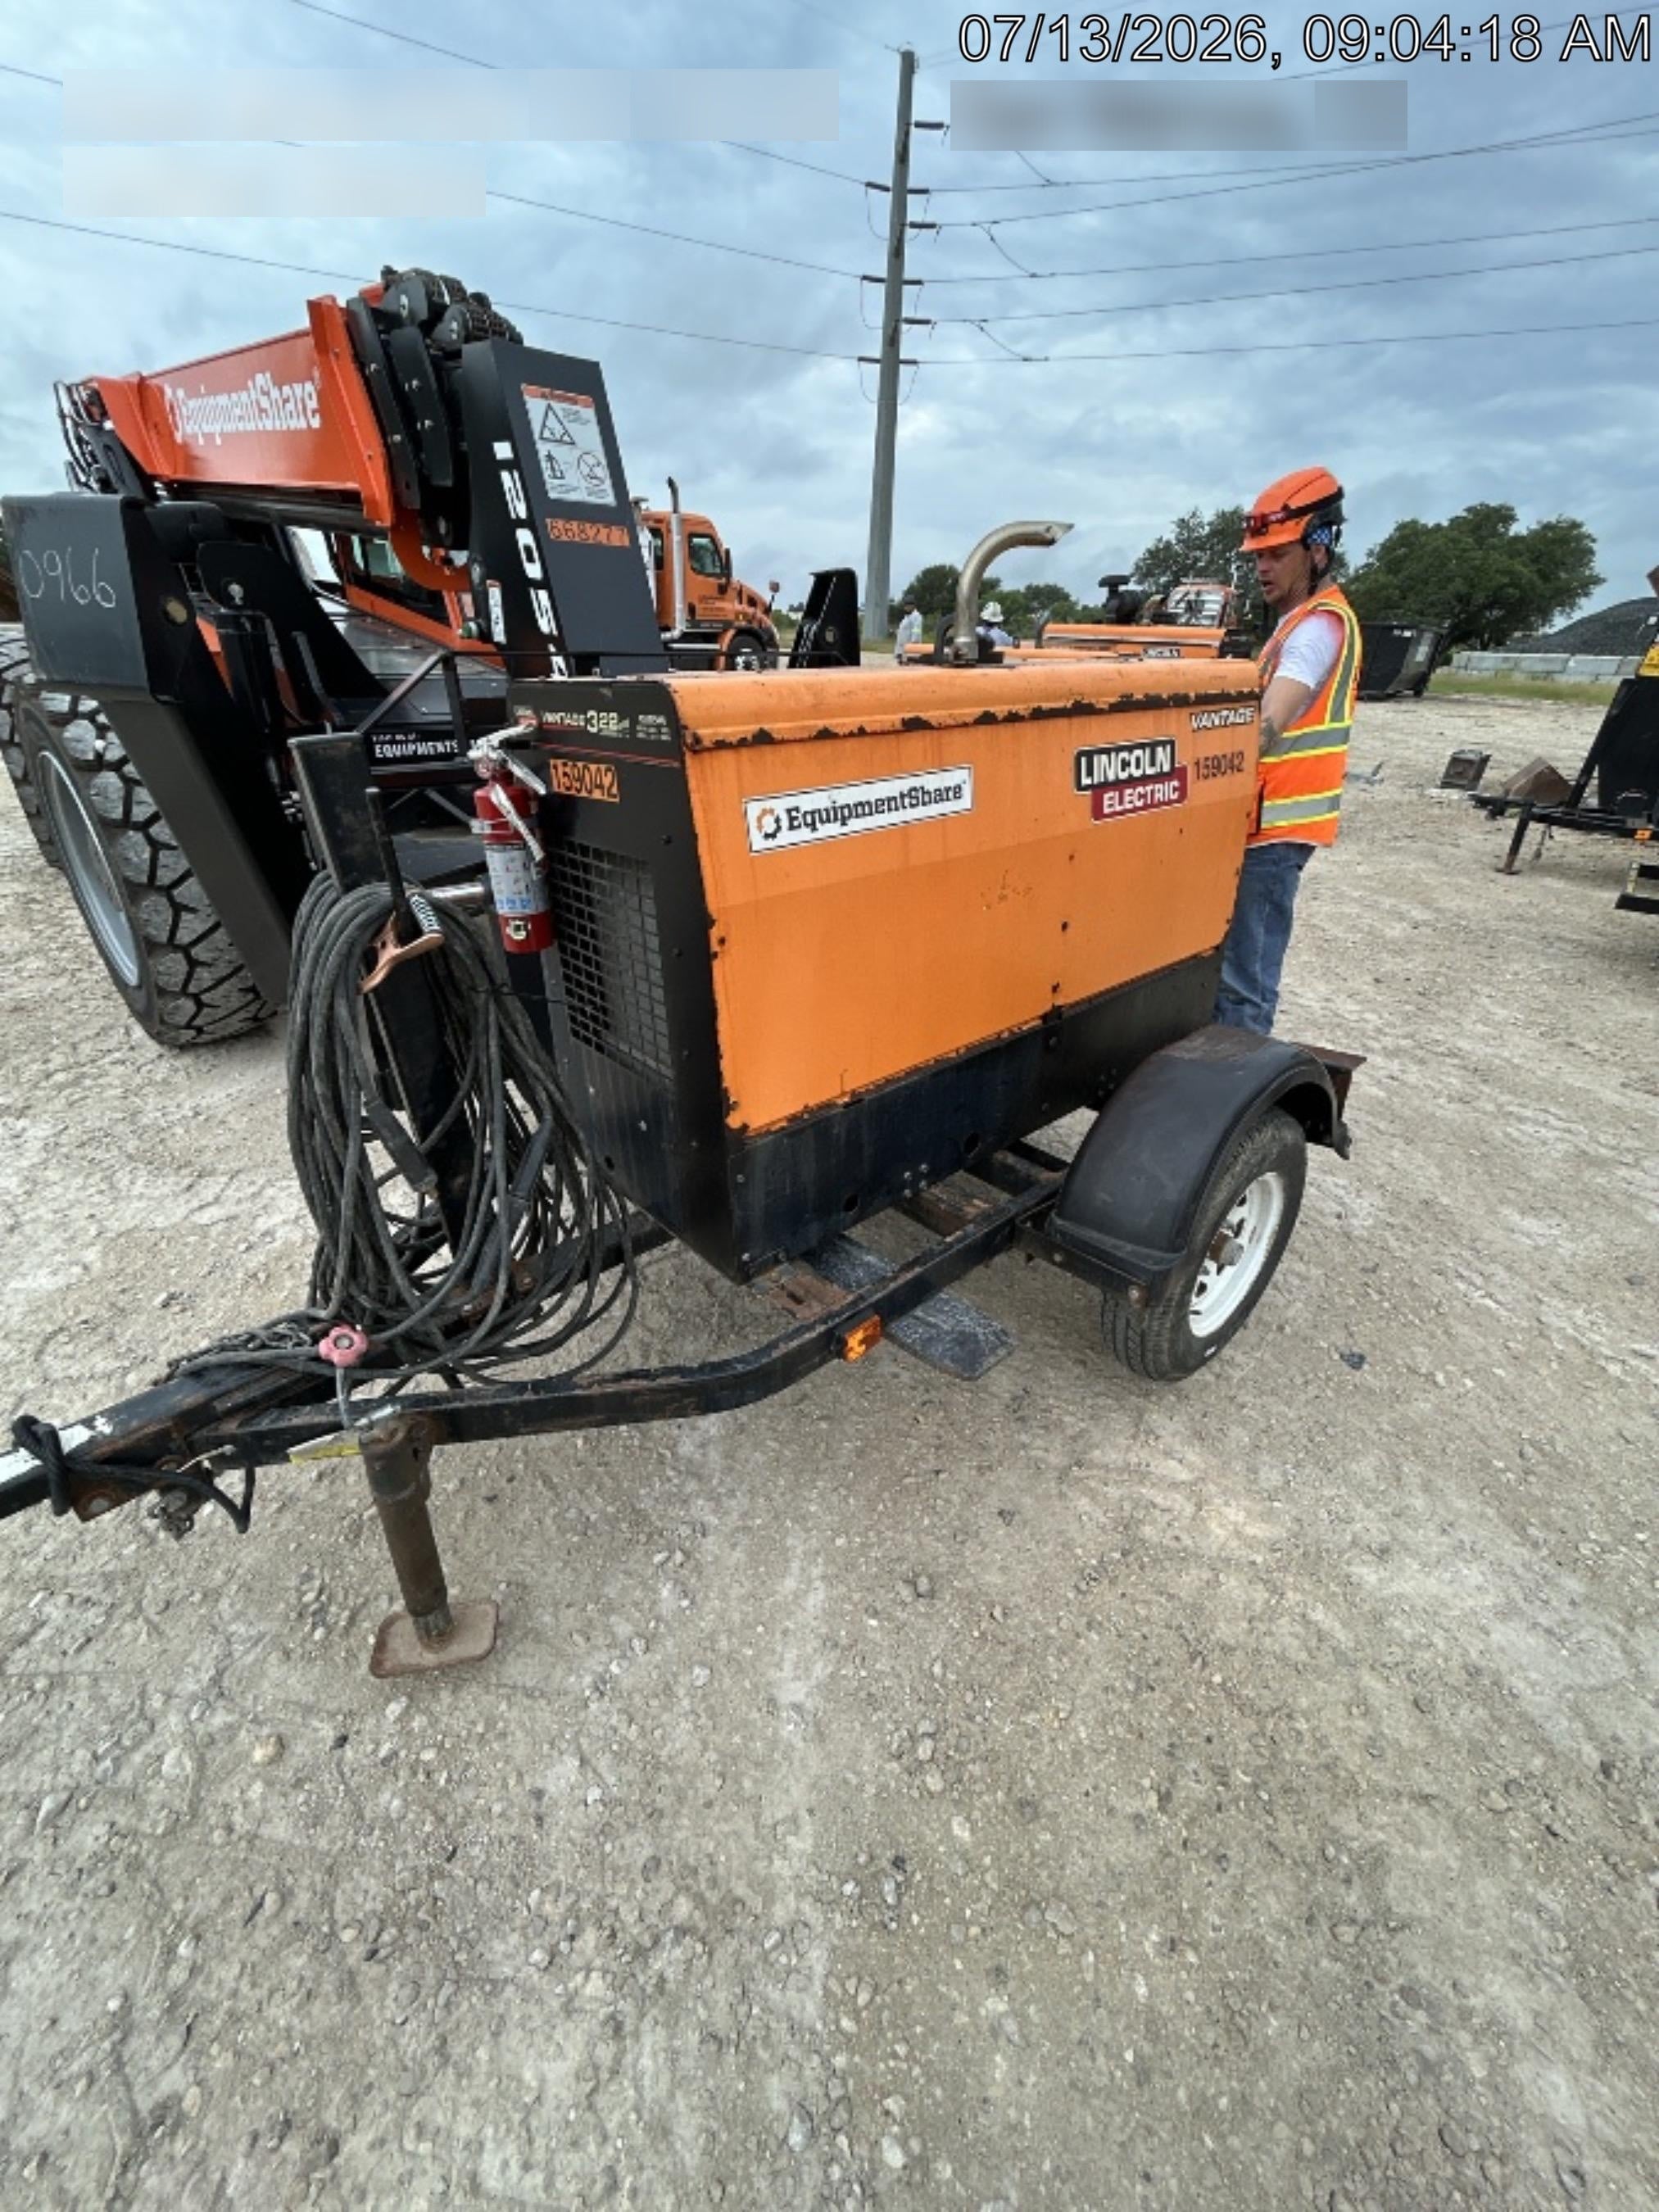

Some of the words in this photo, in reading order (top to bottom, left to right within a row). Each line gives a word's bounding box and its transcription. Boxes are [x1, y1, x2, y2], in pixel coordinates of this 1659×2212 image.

[19, 546, 116, 608] 0966
[1190, 706, 1256, 732] VANTAGE
[552, 761, 618, 800] 159042
[1080, 743, 1172, 787] LINCOLN
[1194, 750, 1244, 781] 159042
[786, 782, 963, 833] EquipmentShare
[1102, 780, 1181, 814] ELECTRIC
